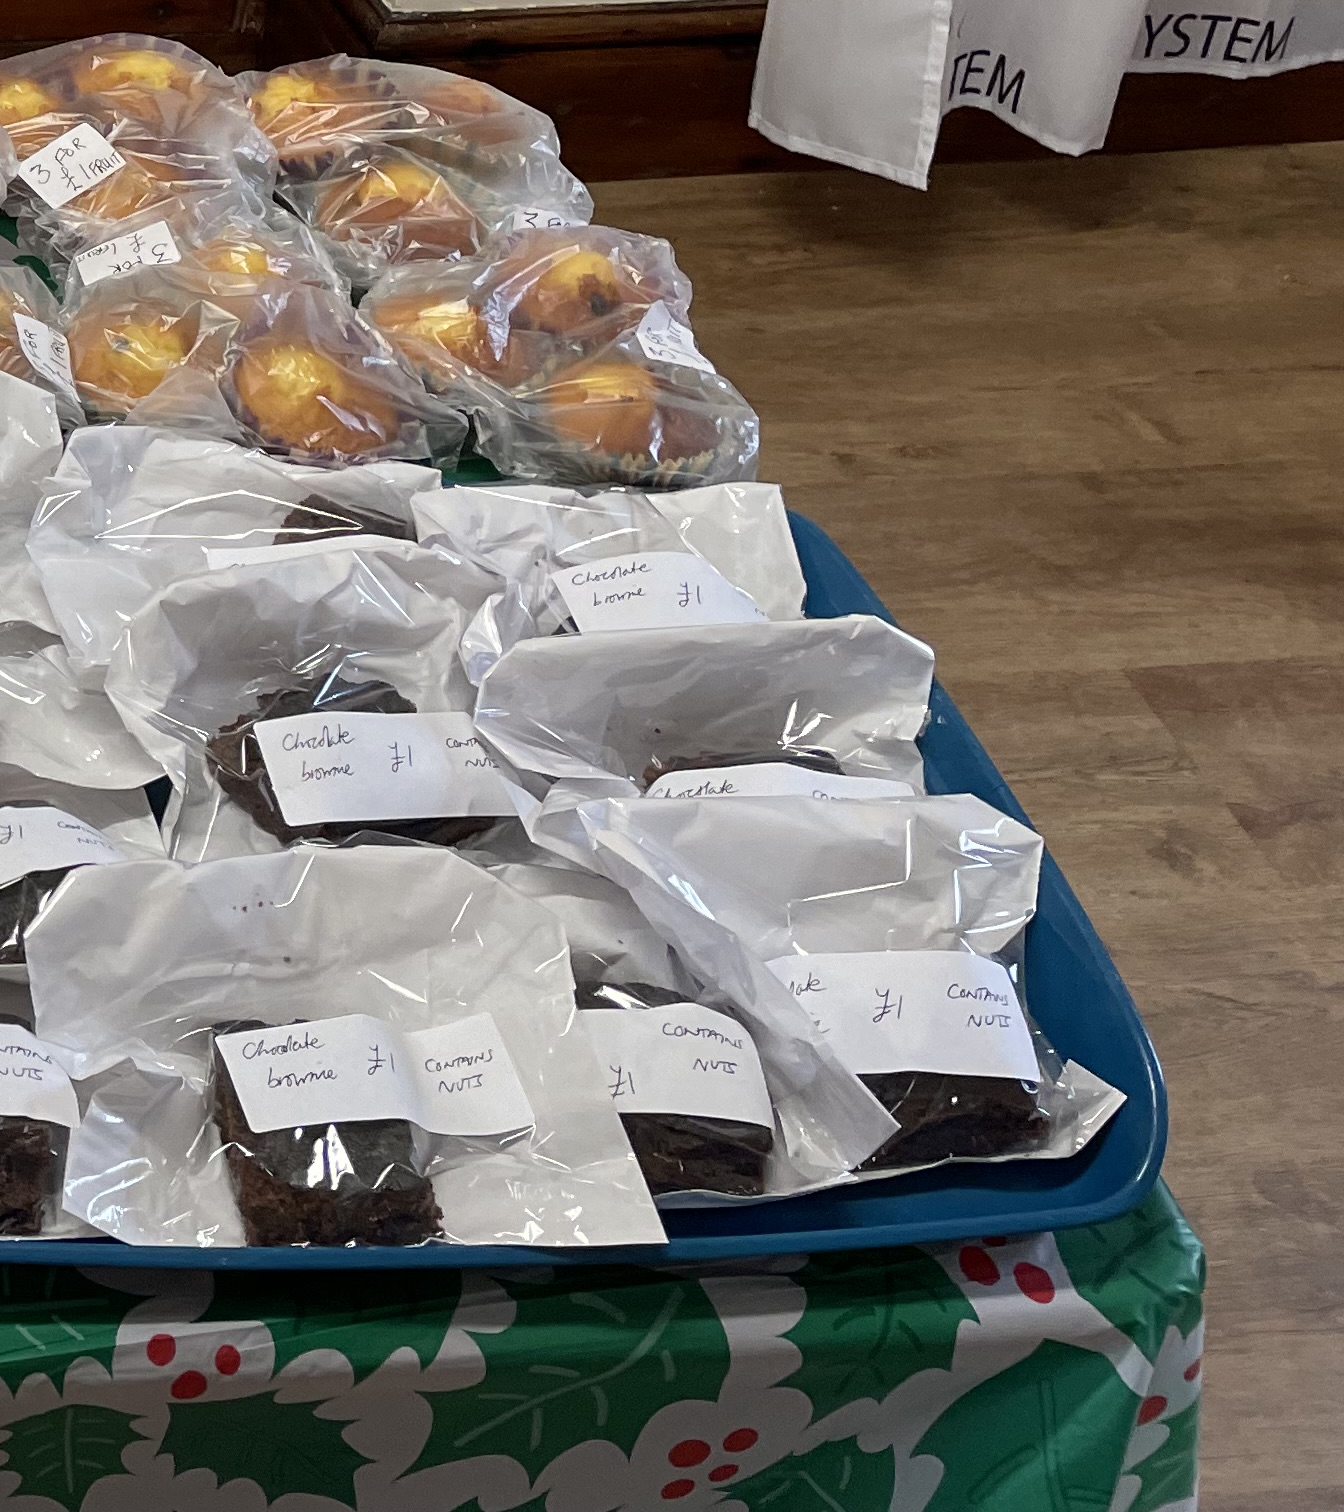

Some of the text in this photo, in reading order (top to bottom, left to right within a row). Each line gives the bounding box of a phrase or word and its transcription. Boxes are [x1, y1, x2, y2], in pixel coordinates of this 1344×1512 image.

[28, 137, 87, 185] 3 FOR
[90, 151, 121, 177] FRUIT
[570, 559, 652, 588] Chocolate
[675, 581, 703, 608] £1
[281, 727, 413, 773] Chocolate £1
[872, 982, 1010, 1024] £1 CONTAINS
[965, 1012, 1012, 1029] NUTS
[661, 1021, 744, 1050] CONTAINS
[240, 1032, 397, 1075] Chocolate £1
[423, 1049, 495, 1076] CONTAINS
[266, 1066, 339, 1091] brownie
[437, 1073, 485, 1093] NUTS
[608, 1058, 739, 1098] £1 NUTS
